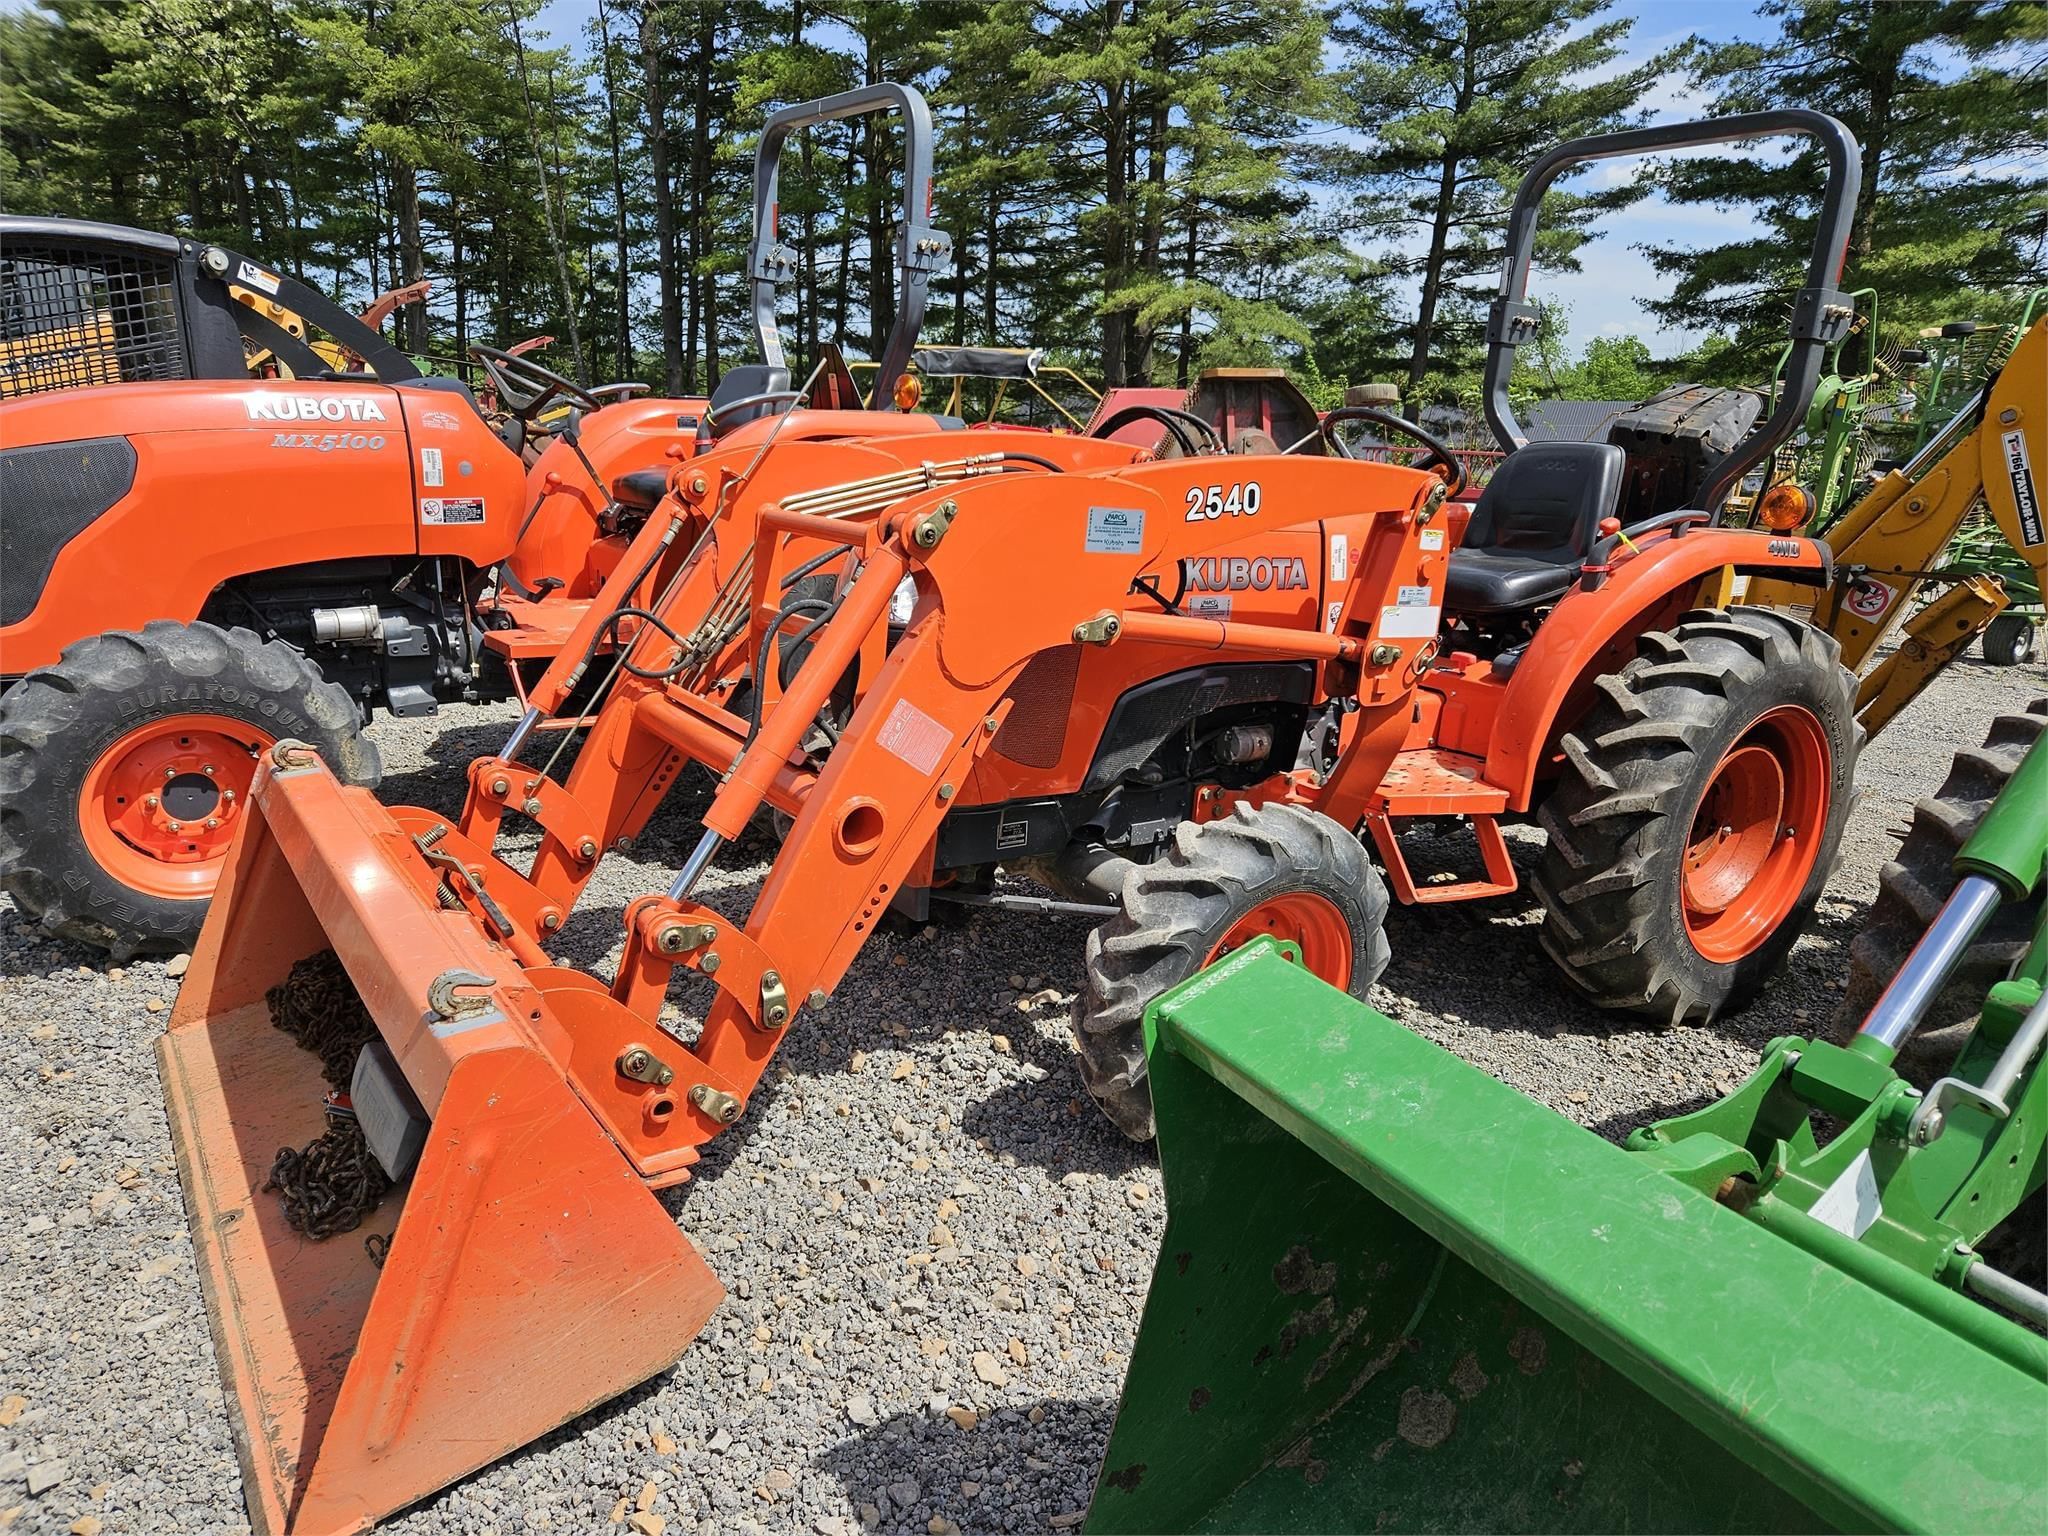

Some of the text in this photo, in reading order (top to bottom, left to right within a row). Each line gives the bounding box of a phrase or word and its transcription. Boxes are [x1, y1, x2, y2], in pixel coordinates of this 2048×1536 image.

[244, 397, 386, 422] KUBOTA
[270, 432, 386, 452] MX5100
[1185, 481, 1262, 522] 2540
[1768, 540, 1800, 557] 4WD
[1185, 557, 1308, 591] KUBOTA
[116, 683, 308, 737] DURATORQUE
